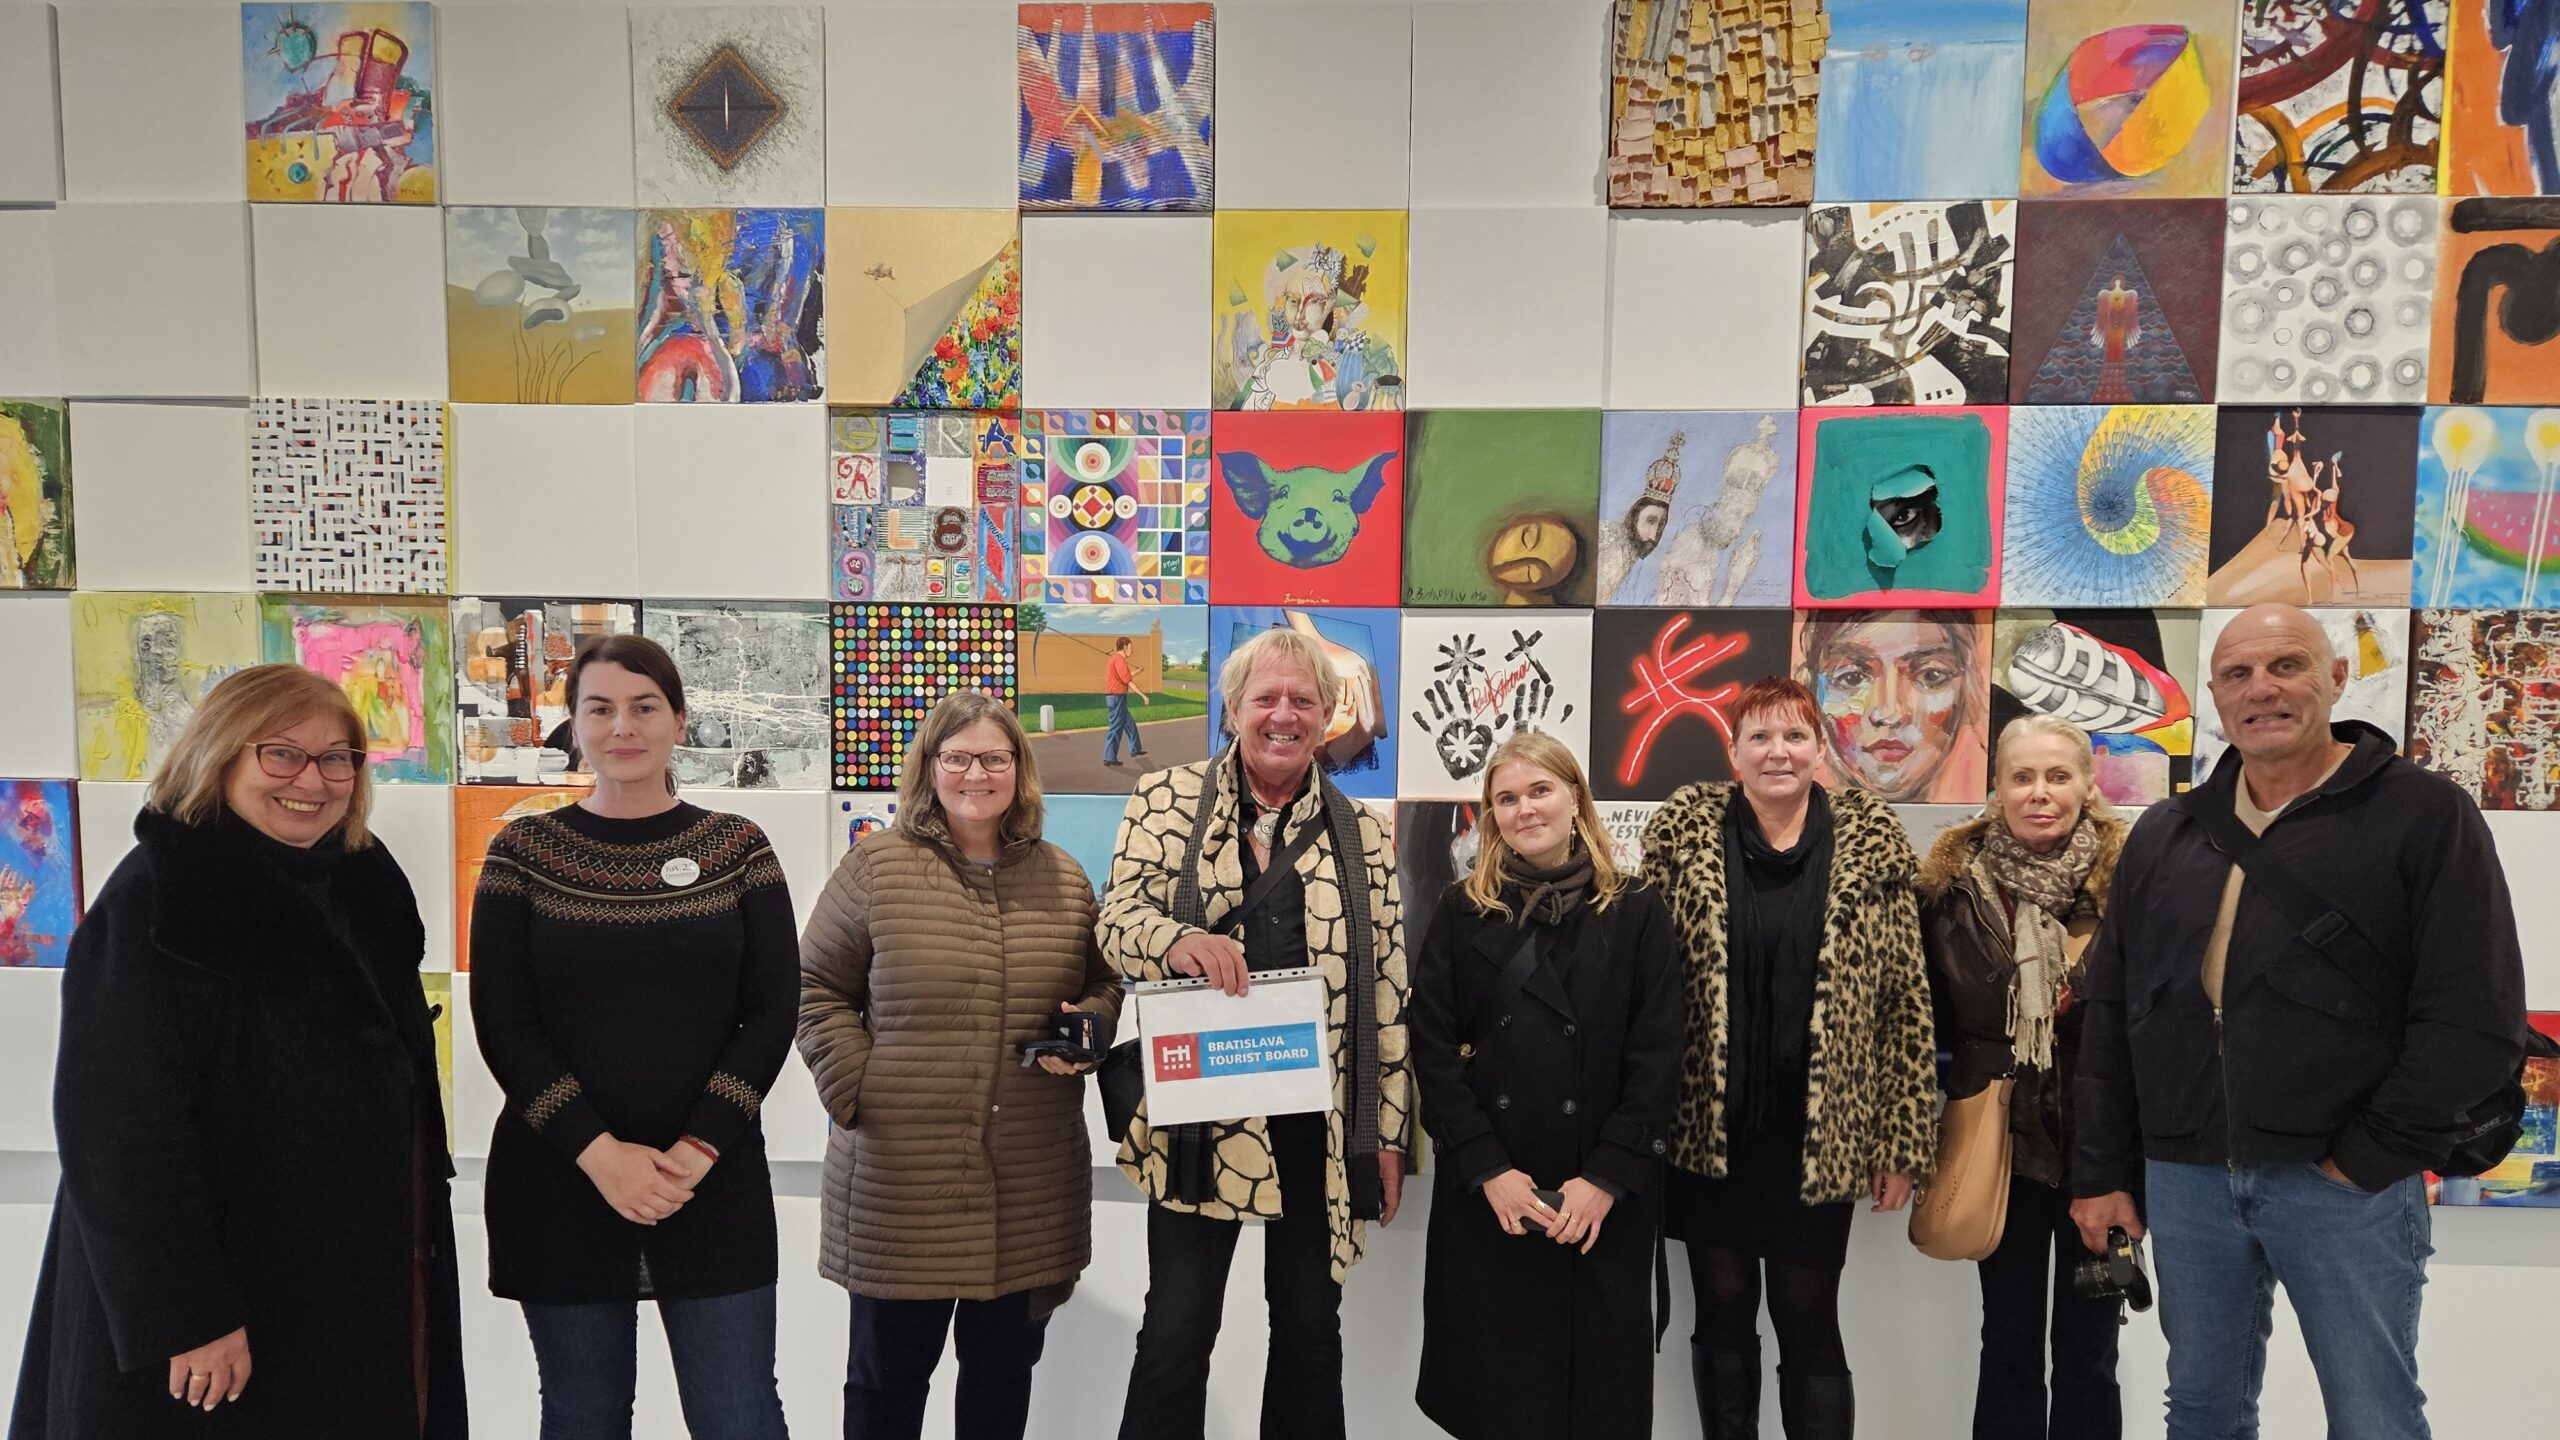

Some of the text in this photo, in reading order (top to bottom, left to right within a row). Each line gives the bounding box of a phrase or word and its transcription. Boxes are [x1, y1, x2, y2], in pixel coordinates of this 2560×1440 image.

[1208, 1036, 1285, 1052] BRATISLAVA
[1208, 1048, 1309, 1067] TOURIST BOARD
